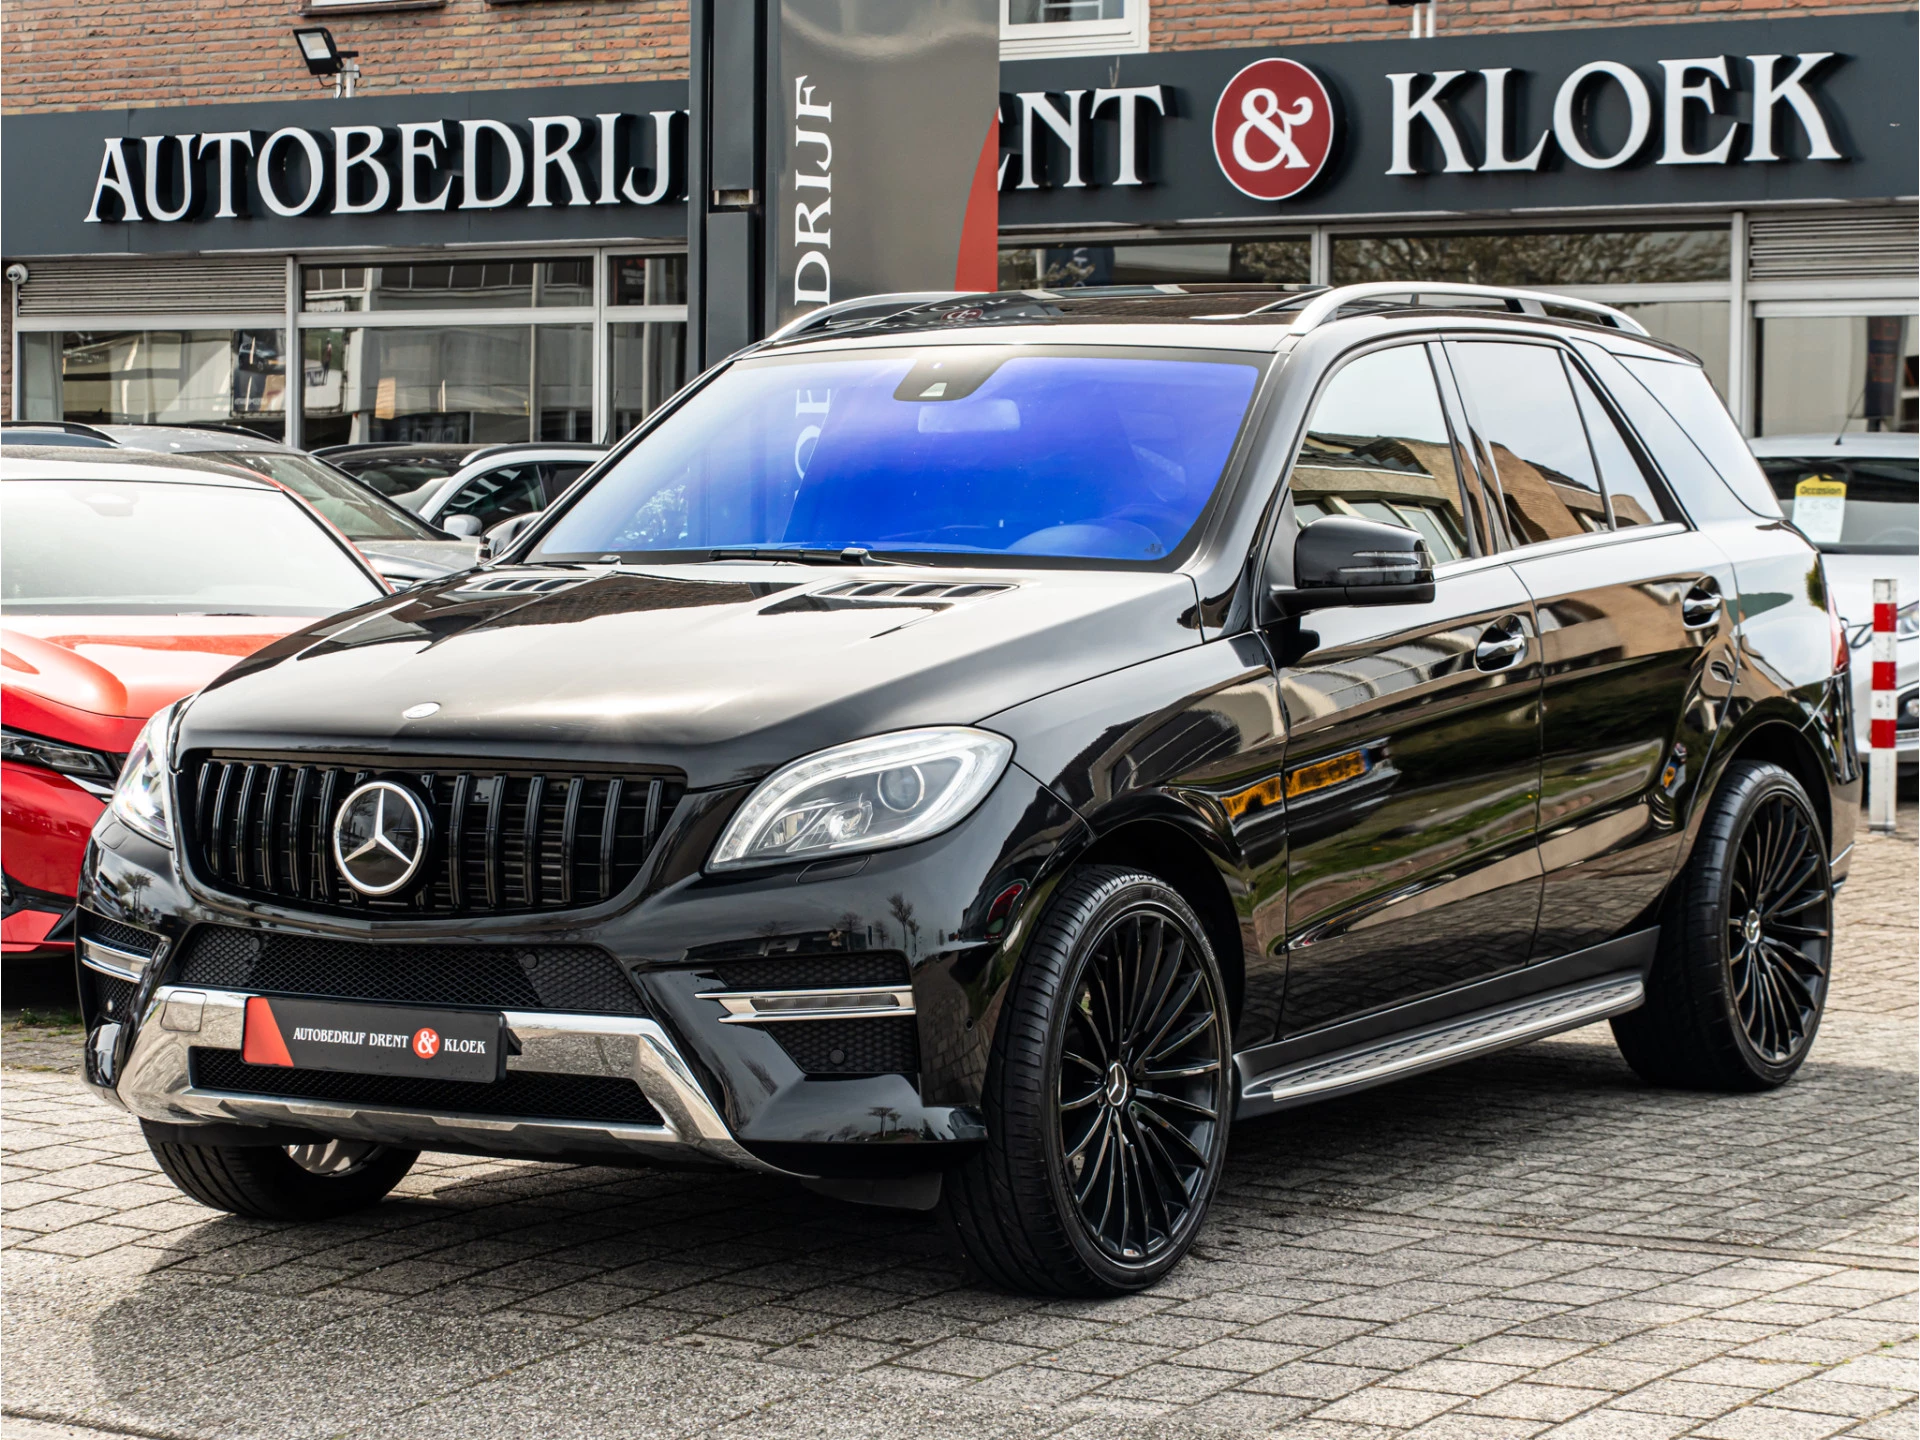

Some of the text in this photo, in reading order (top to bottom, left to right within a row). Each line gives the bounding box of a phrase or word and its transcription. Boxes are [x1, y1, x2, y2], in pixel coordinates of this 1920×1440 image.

[84, 109, 690, 222] AUTOBEDRIJ
[1232, 87, 1314, 172] &
[1385, 53, 1843, 175] KLOEK
[1799, 486, 1843, 495] Occasion
[292, 1027, 486, 1055] AUTOBEDRIJF DRENT & KLOEK
